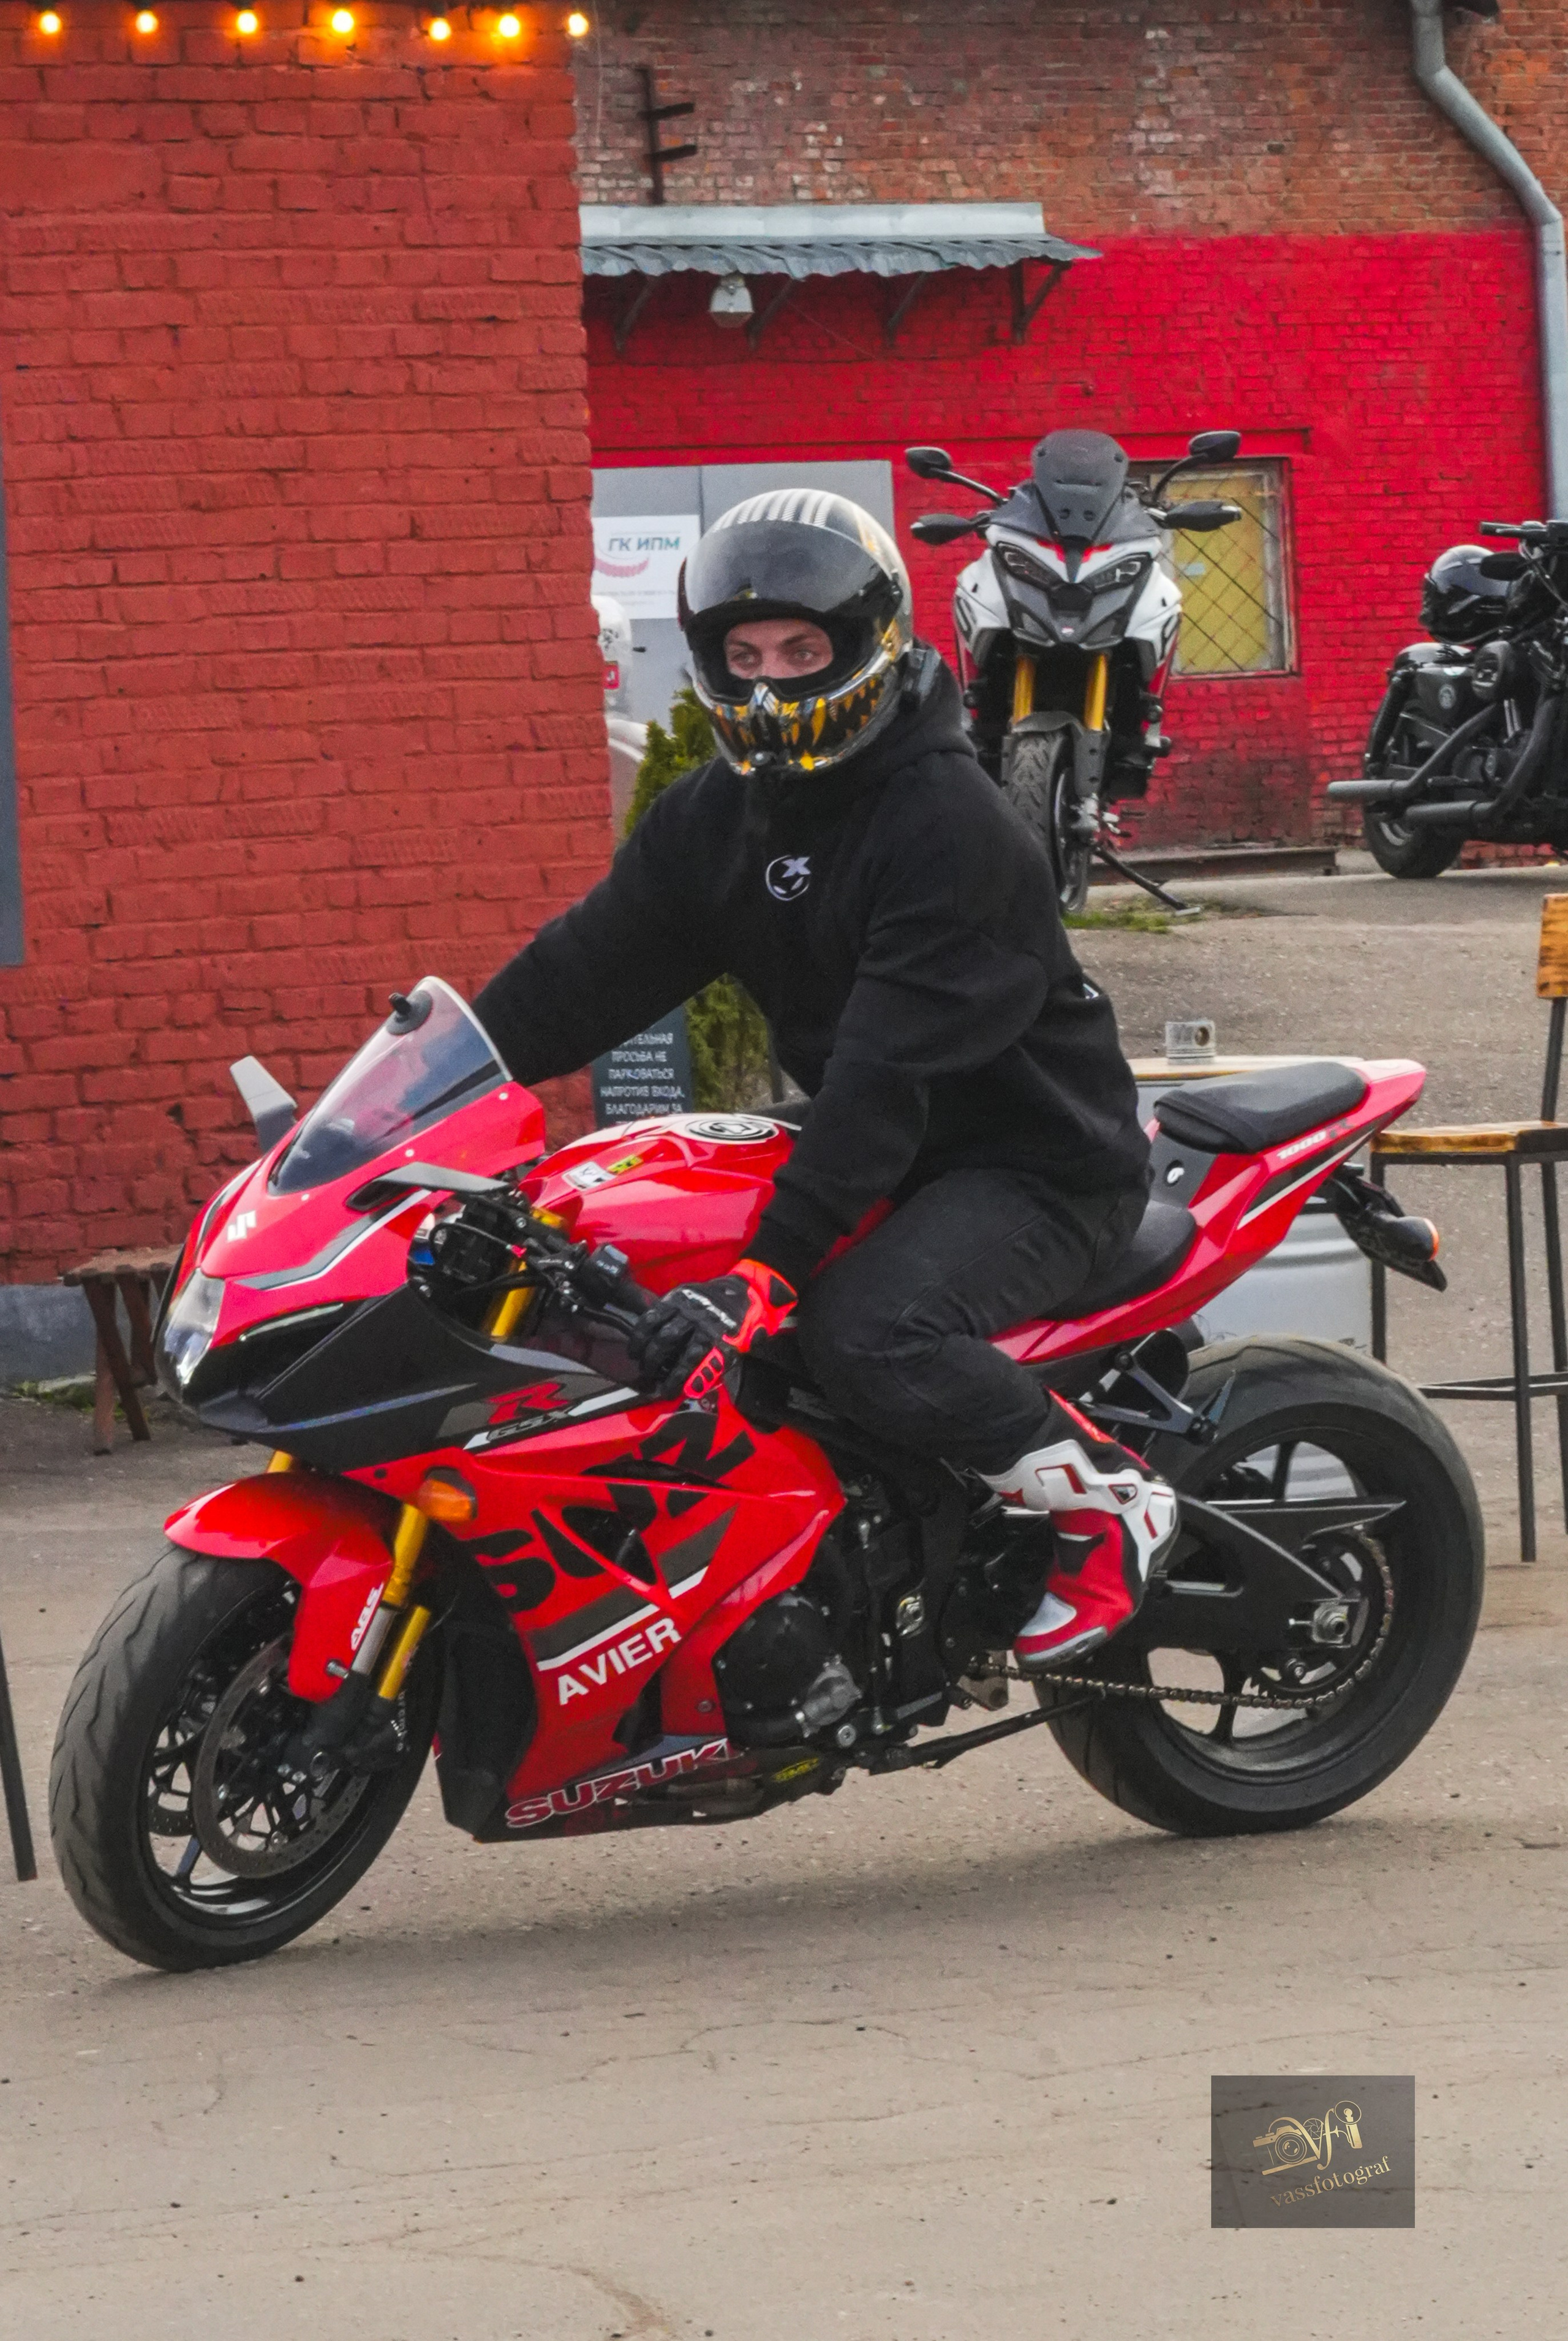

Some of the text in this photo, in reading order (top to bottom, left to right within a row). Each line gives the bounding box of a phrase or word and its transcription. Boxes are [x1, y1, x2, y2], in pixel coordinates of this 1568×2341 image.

[608, 536, 680, 551] ГК ИПМ
[611, 1050, 667, 1062] ПРОСЬБА НЕ
[608, 1067, 674, 1080] ПАРКОВАТЬСЯ
[600, 1086, 649, 1097] НАПРОТИВ
[557, 1617, 682, 1706] AVIER
